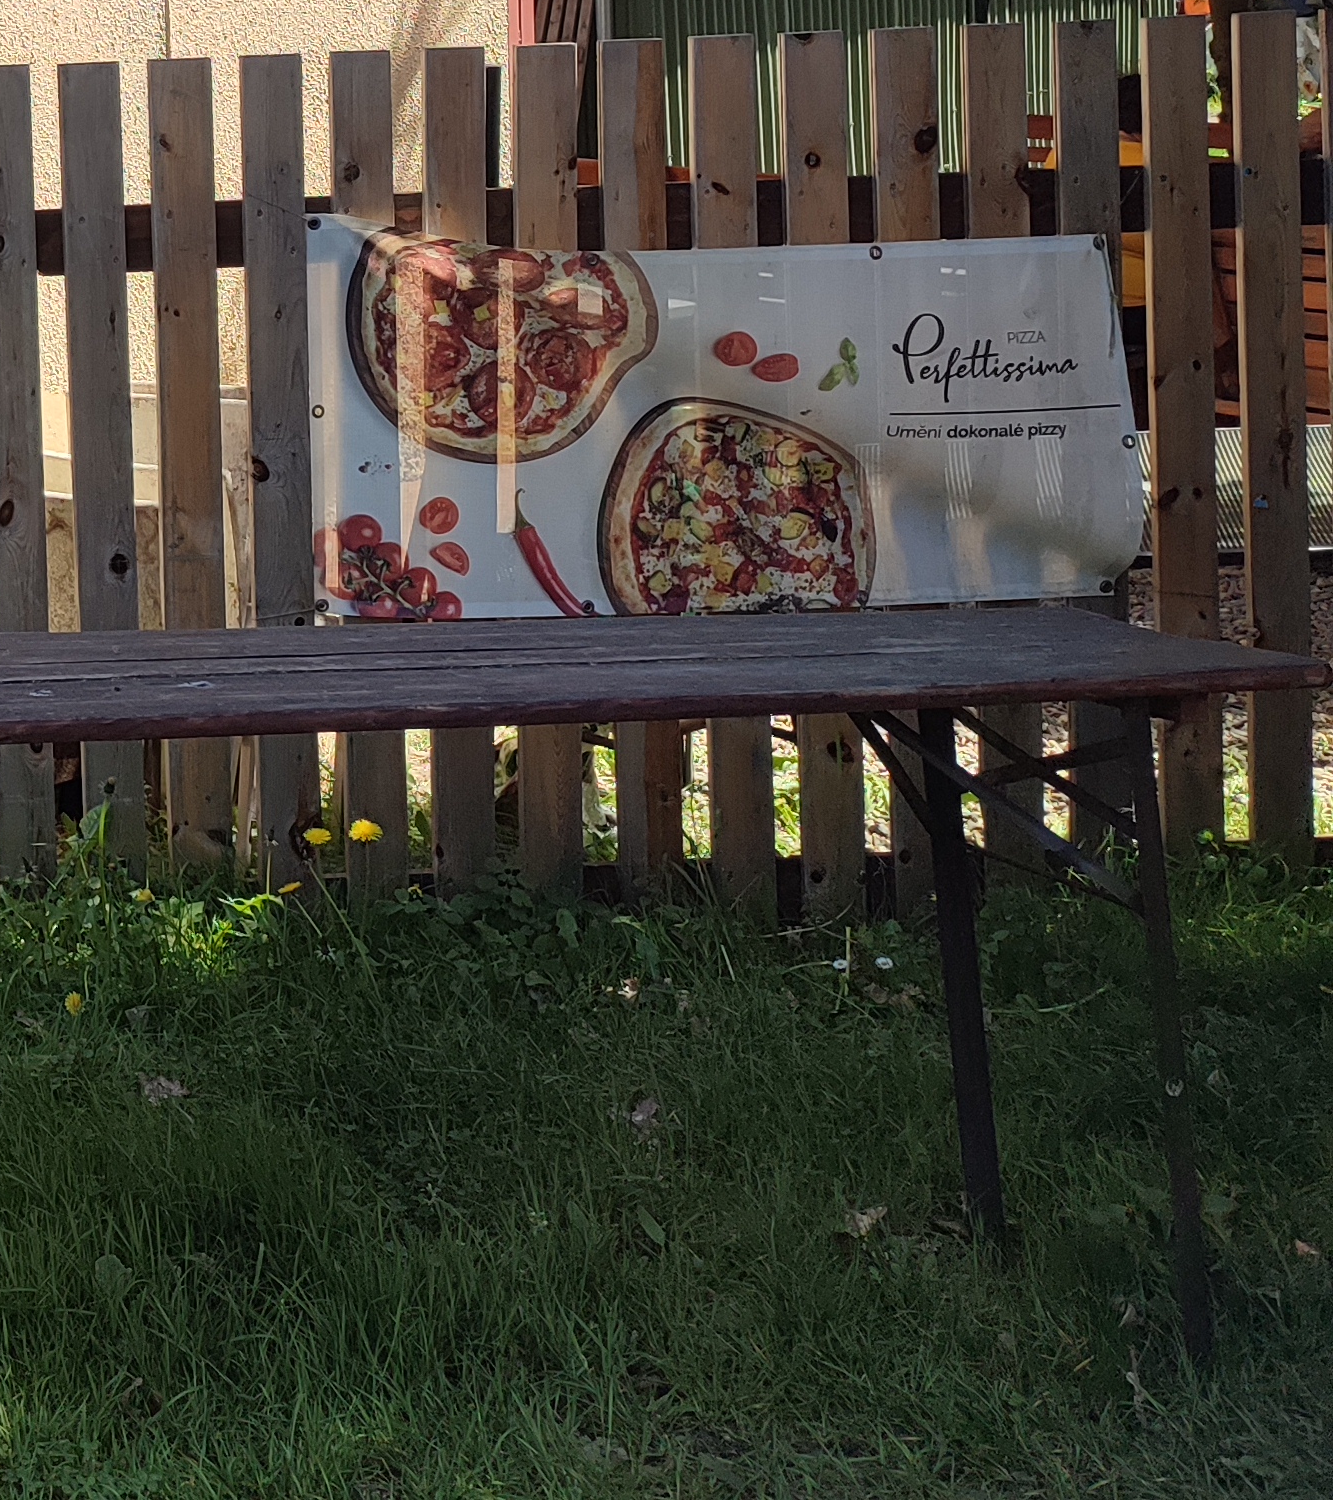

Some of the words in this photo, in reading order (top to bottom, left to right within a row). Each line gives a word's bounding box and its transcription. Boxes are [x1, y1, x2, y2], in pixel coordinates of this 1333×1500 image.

[892, 312, 1079, 403] Perfettissima
[886, 423, 943, 439] Umění
[946, 422, 1024, 439] dokonalé
[1027, 424, 1067, 440] pizzy
